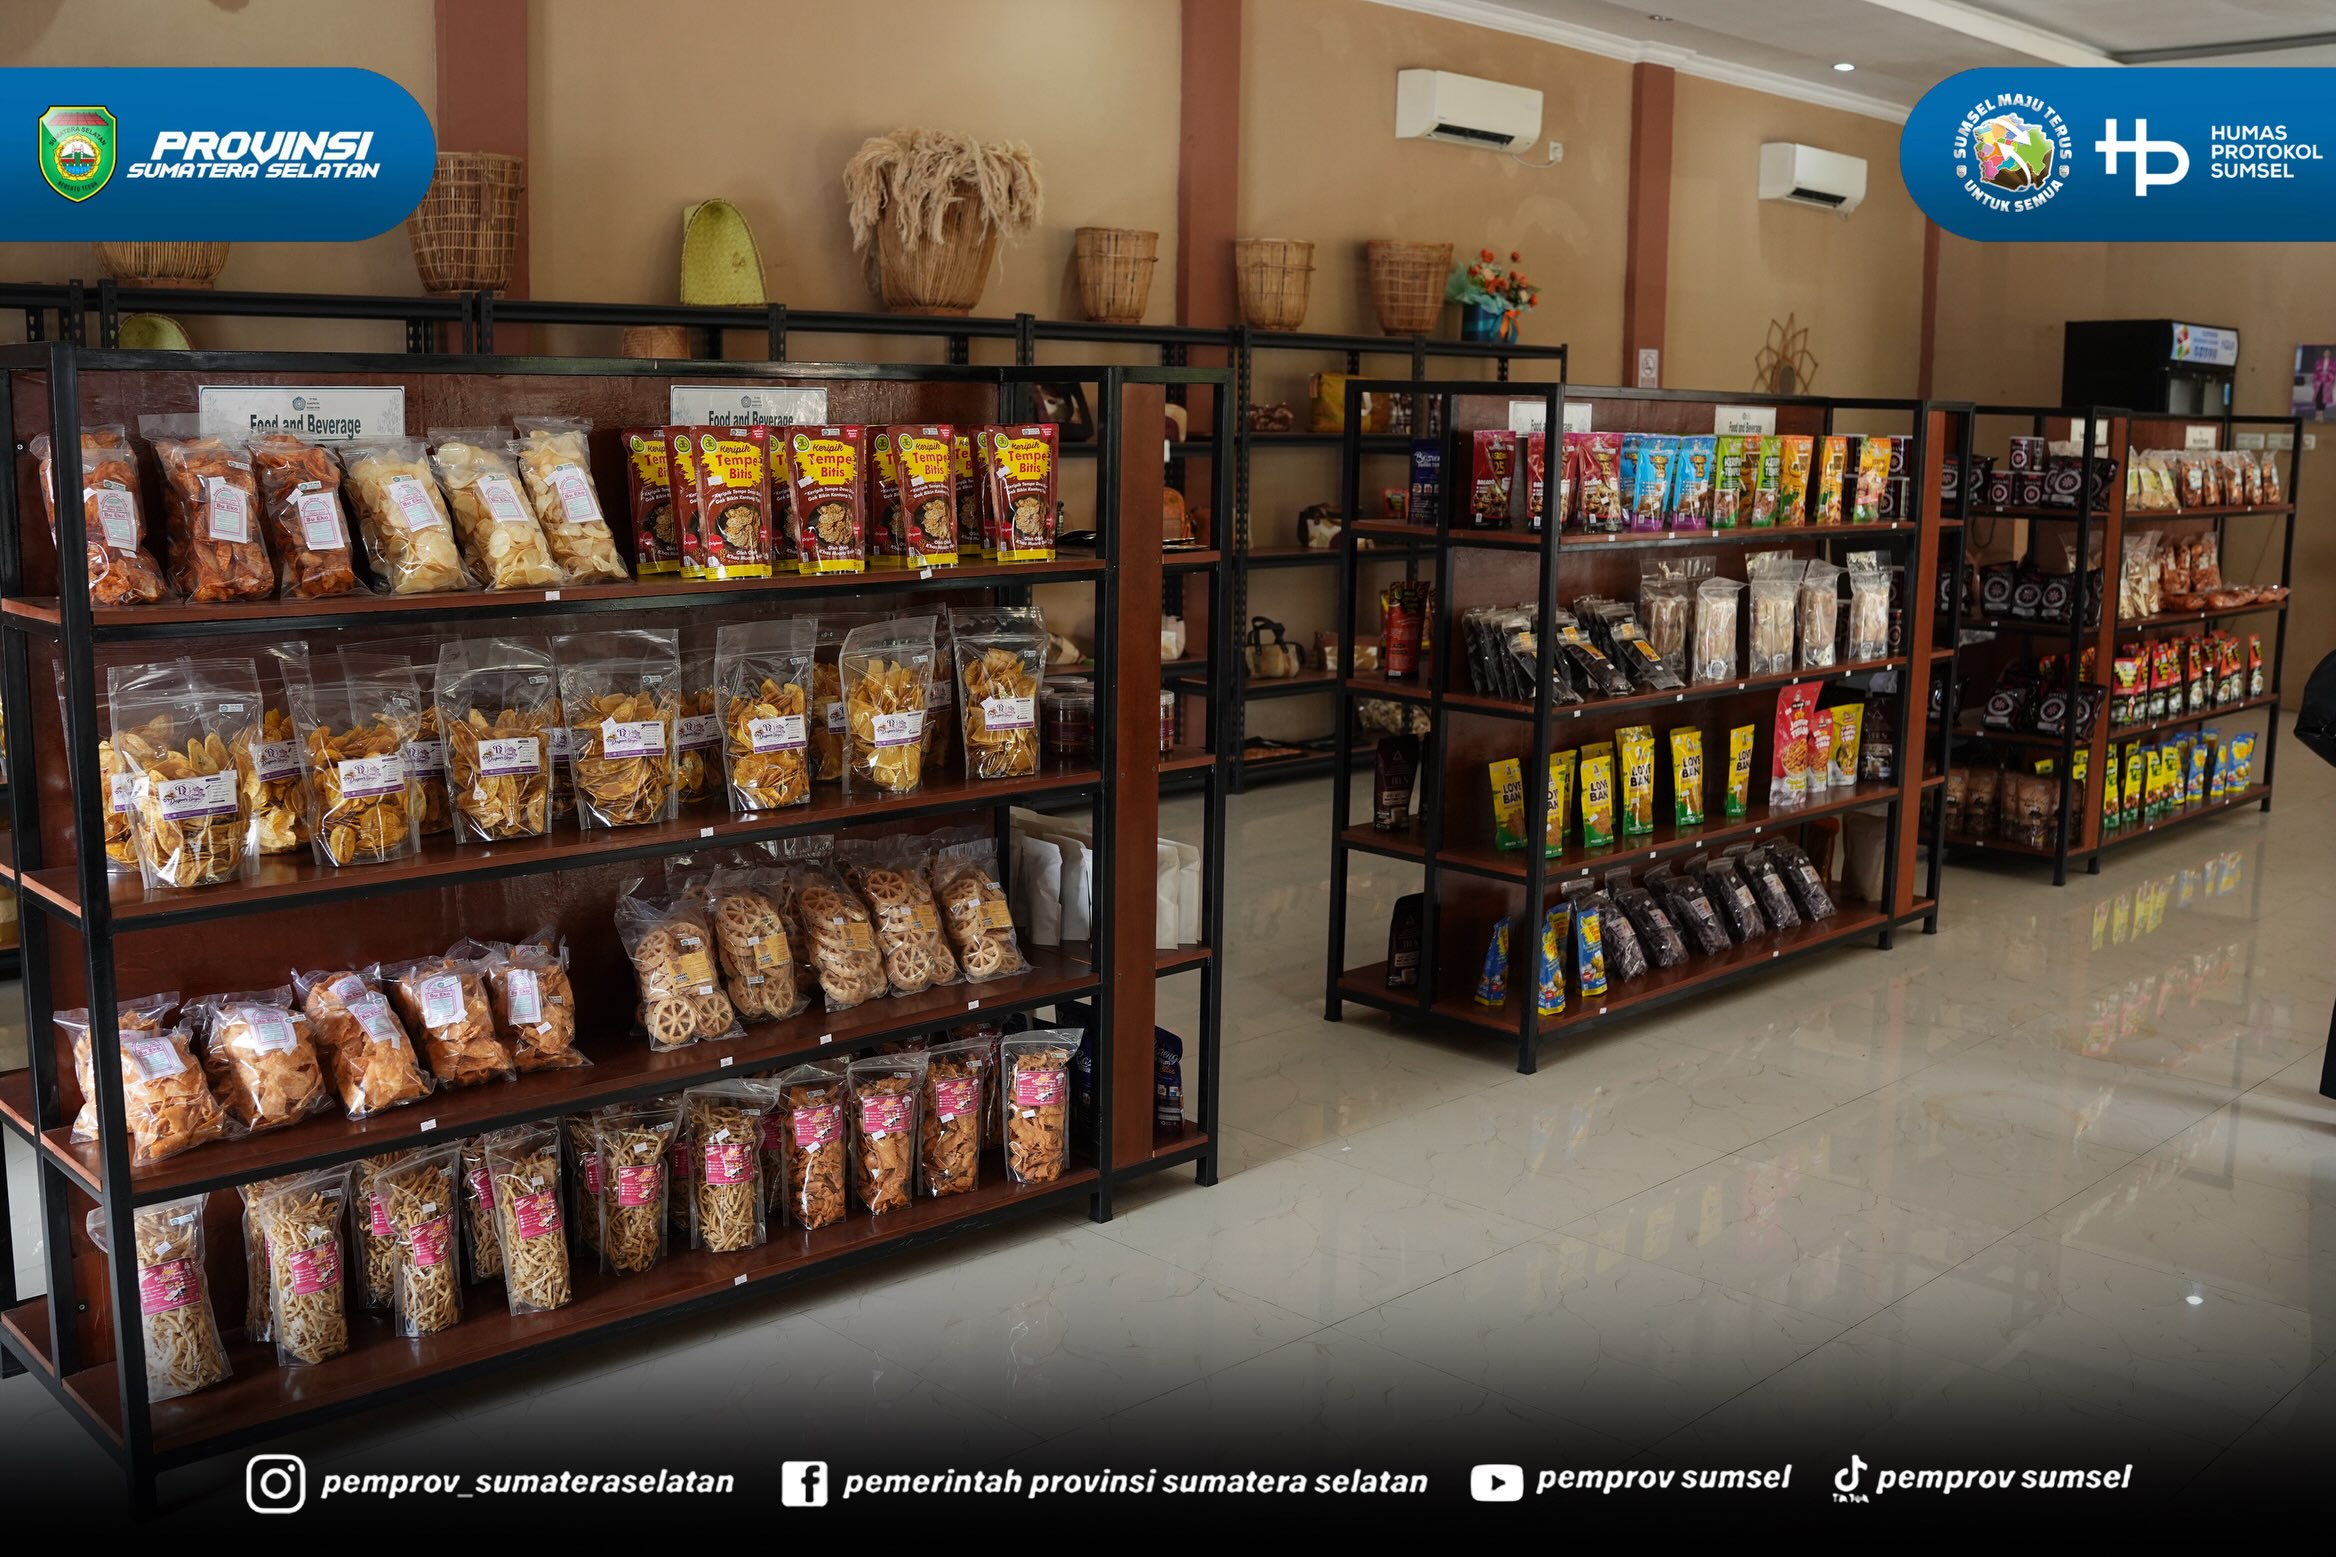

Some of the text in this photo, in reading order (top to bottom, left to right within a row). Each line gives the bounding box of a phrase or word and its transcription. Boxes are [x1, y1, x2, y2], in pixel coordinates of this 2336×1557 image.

[708, 410, 794, 426] Food and Beverage
[250, 414, 361, 439] Food and Beverage
[720, 445, 751, 455] Keripik
[813, 443, 844, 453] Keripik
[916, 442, 941, 452] Keripik
[1012, 441, 1041, 451] Keripik
[644, 454, 667, 466] Tem
[715, 454, 758, 467] Tempe
[807, 453, 852, 466] Tempe
[913, 452, 948, 464] Tempe
[1007, 450, 1047, 462] Tempe
[729, 468, 752, 479] Bitis
[821, 467, 845, 477] Bitis
[925, 464, 944, 475] Bitis
[1020, 463, 1041, 473] Bitis
